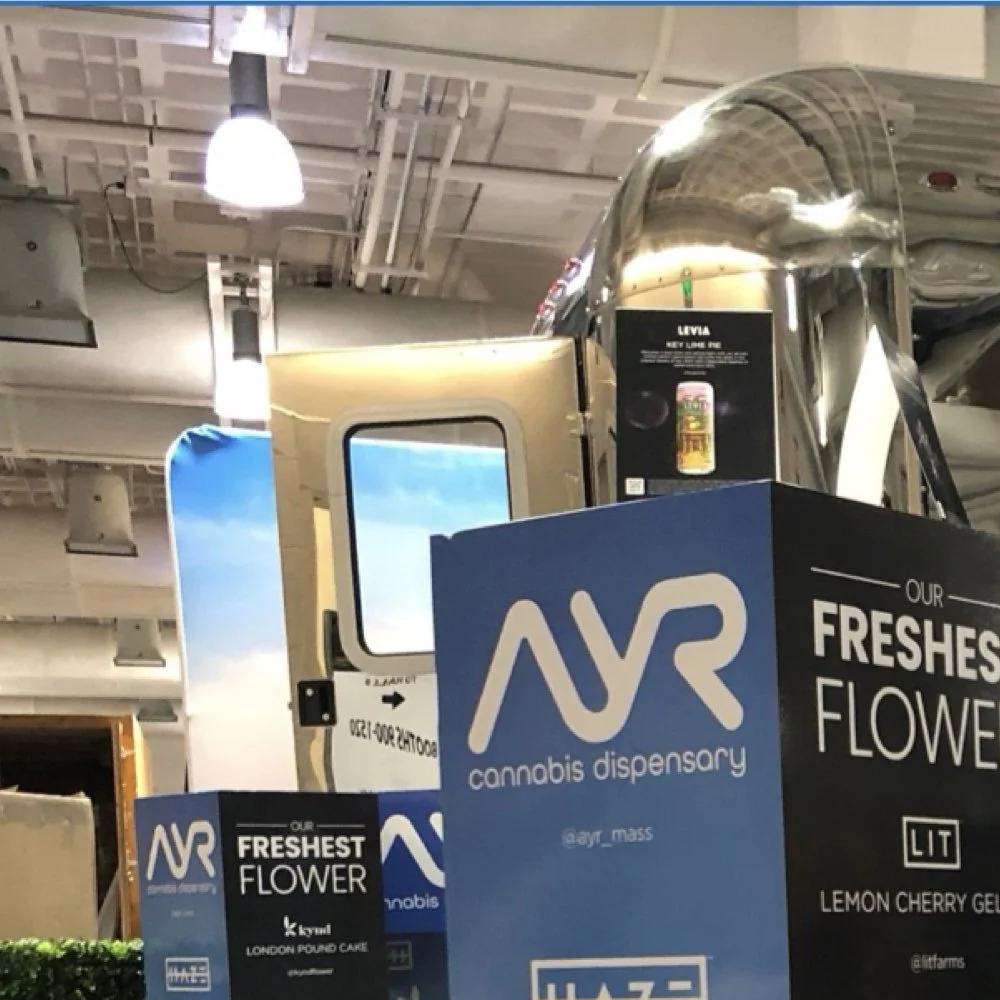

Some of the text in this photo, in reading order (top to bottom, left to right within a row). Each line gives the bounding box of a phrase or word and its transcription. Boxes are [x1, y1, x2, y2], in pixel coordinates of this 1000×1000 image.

[678, 326, 711, 336] LEVIA
[905, 578, 944, 608] OUR
[467, 573, 748, 754] AYR
[468, 746, 747, 790] cannabis dispensary
[290, 821, 315, 832] OUR
[562, 825, 654, 849] @ayr_mass
[146, 820, 216, 881] AYR
[236, 836, 366, 860] FRESHEST
[911, 828, 952, 858] LIT
[239, 864, 368, 896] FLOWER
[384, 893, 439, 911] nnabis
[820, 889, 890, 913] LEMON
[895, 890, 967, 914] CHERRY
[246, 941, 369, 957] LONDON POUND CAKE
